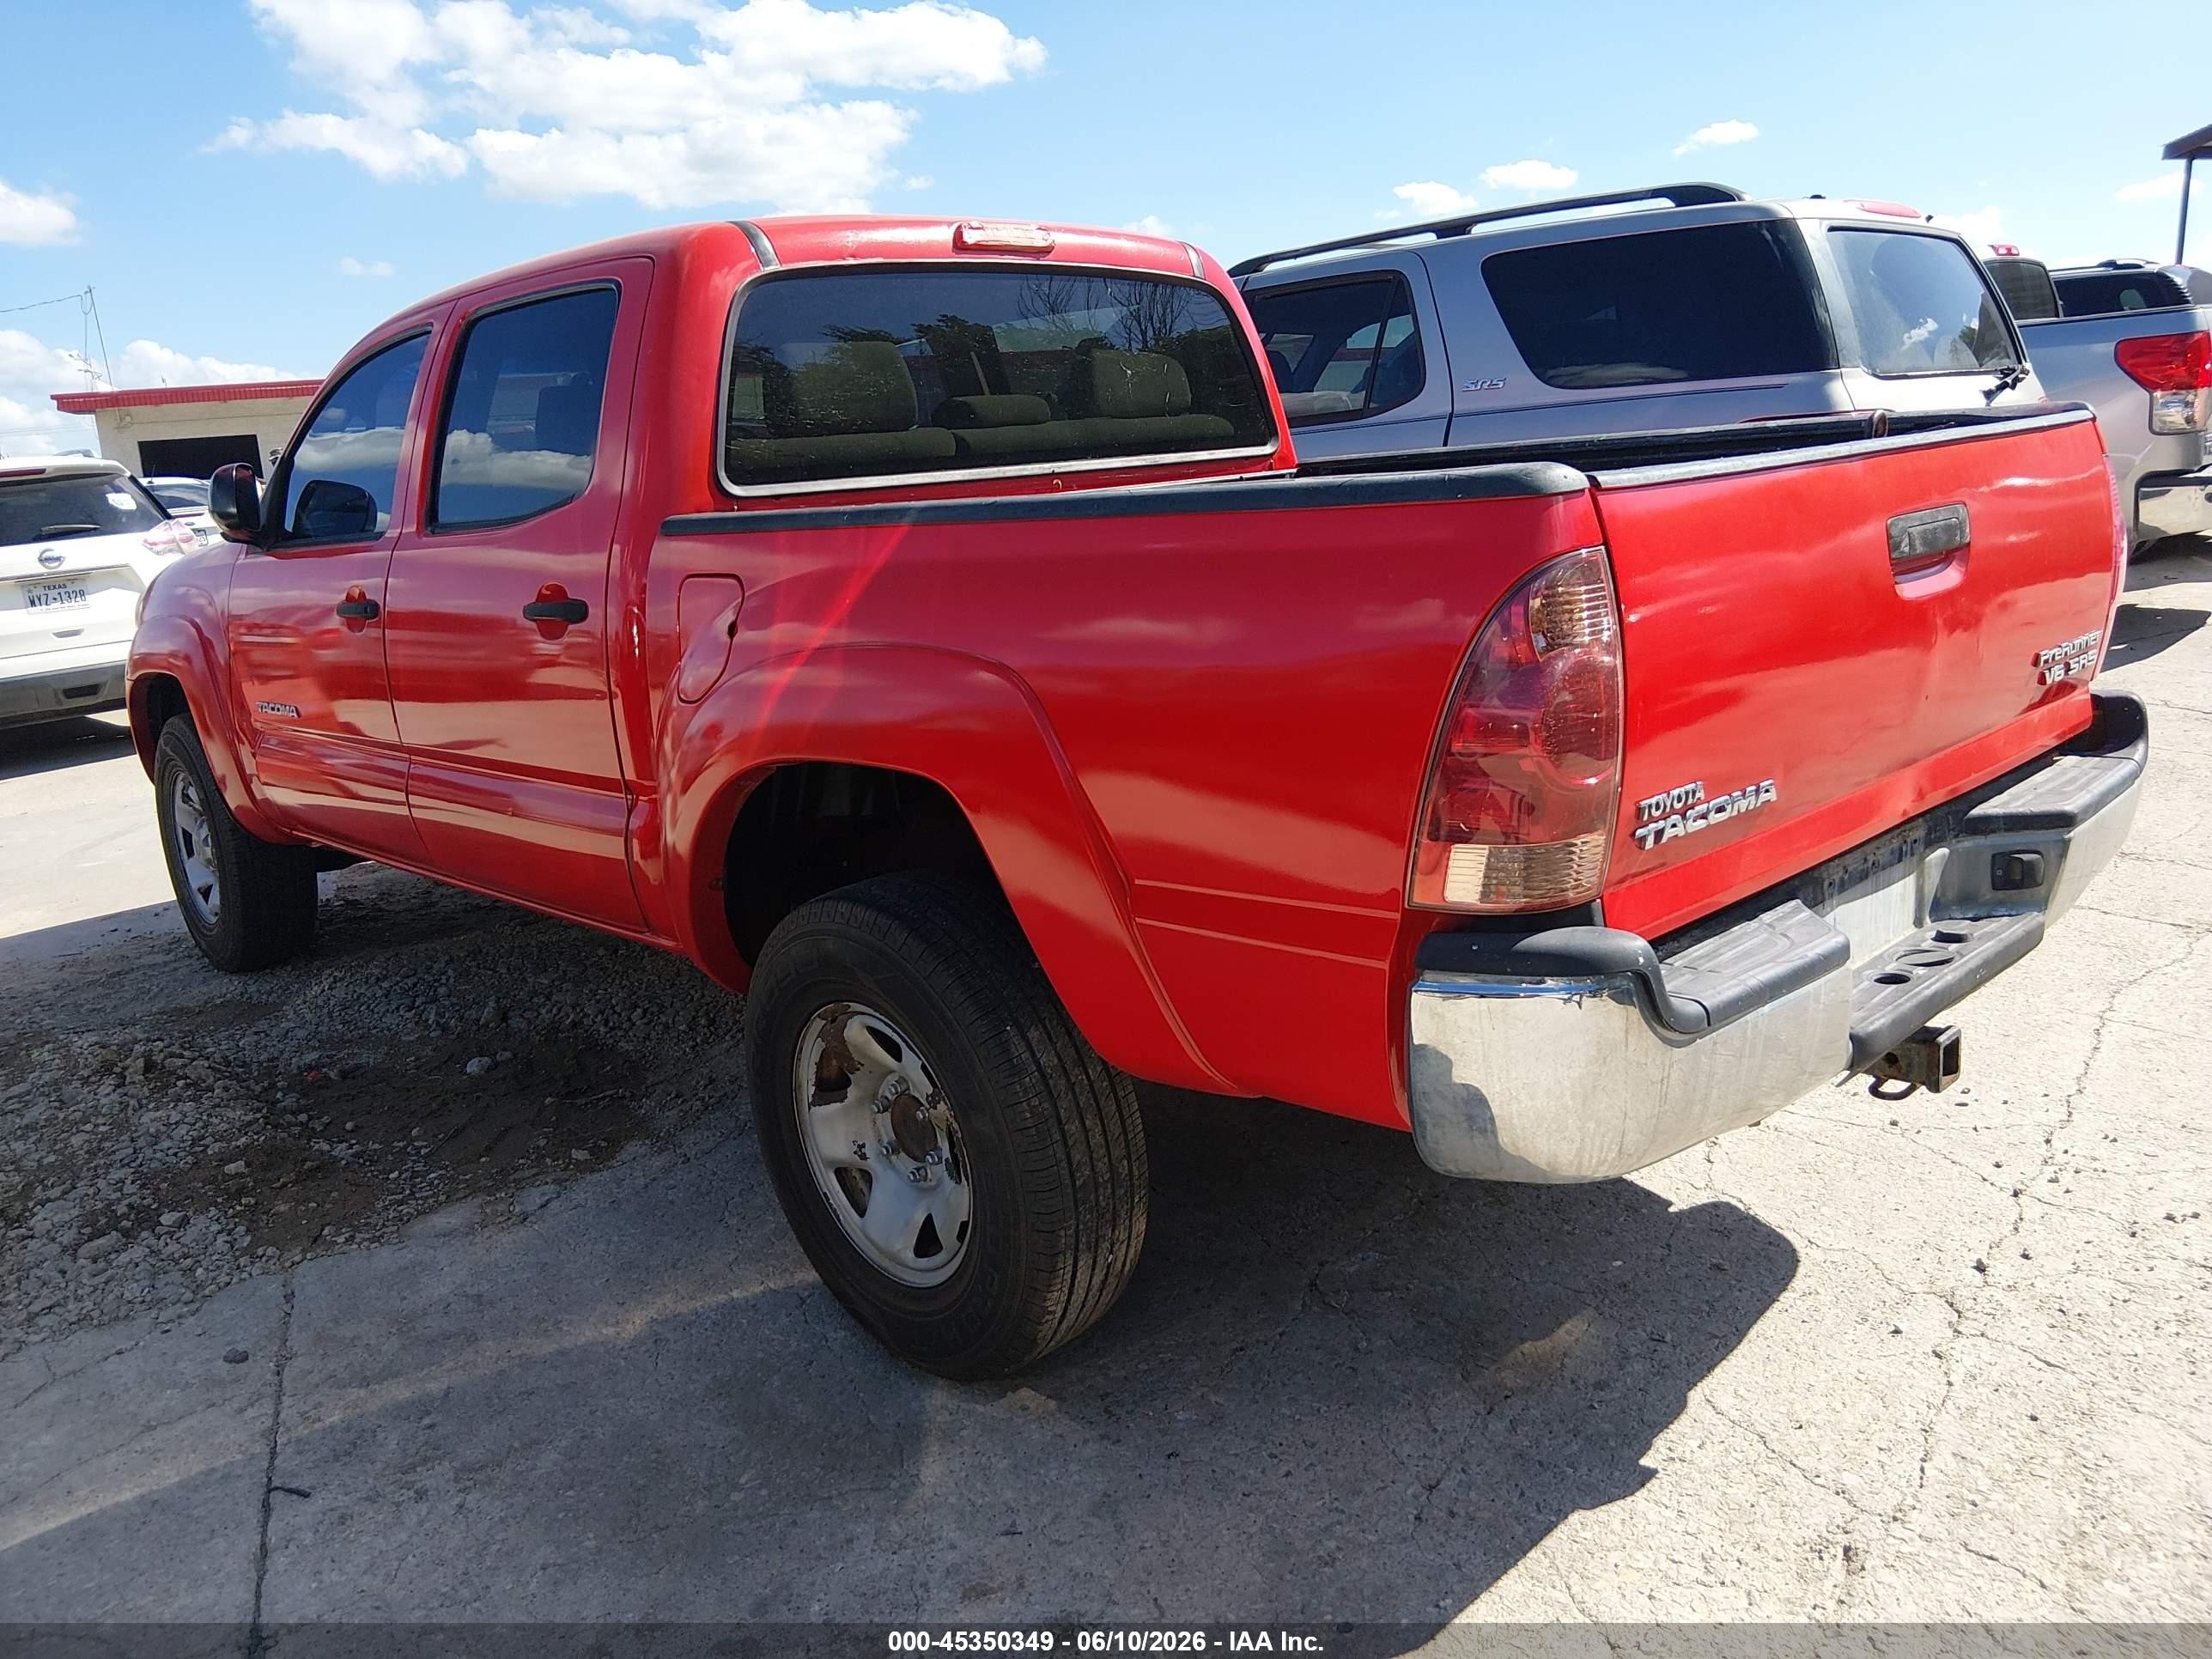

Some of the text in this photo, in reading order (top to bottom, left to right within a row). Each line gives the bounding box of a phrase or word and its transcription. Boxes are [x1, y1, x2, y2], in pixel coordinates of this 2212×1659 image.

[42, 583, 68, 592] TEXAS
[2044, 664, 2065, 685] V6
[256, 701, 301, 719] TACOMA
[1637, 780, 1706, 822] TOYOTA
[1634, 778, 1778, 850] TACOMA
